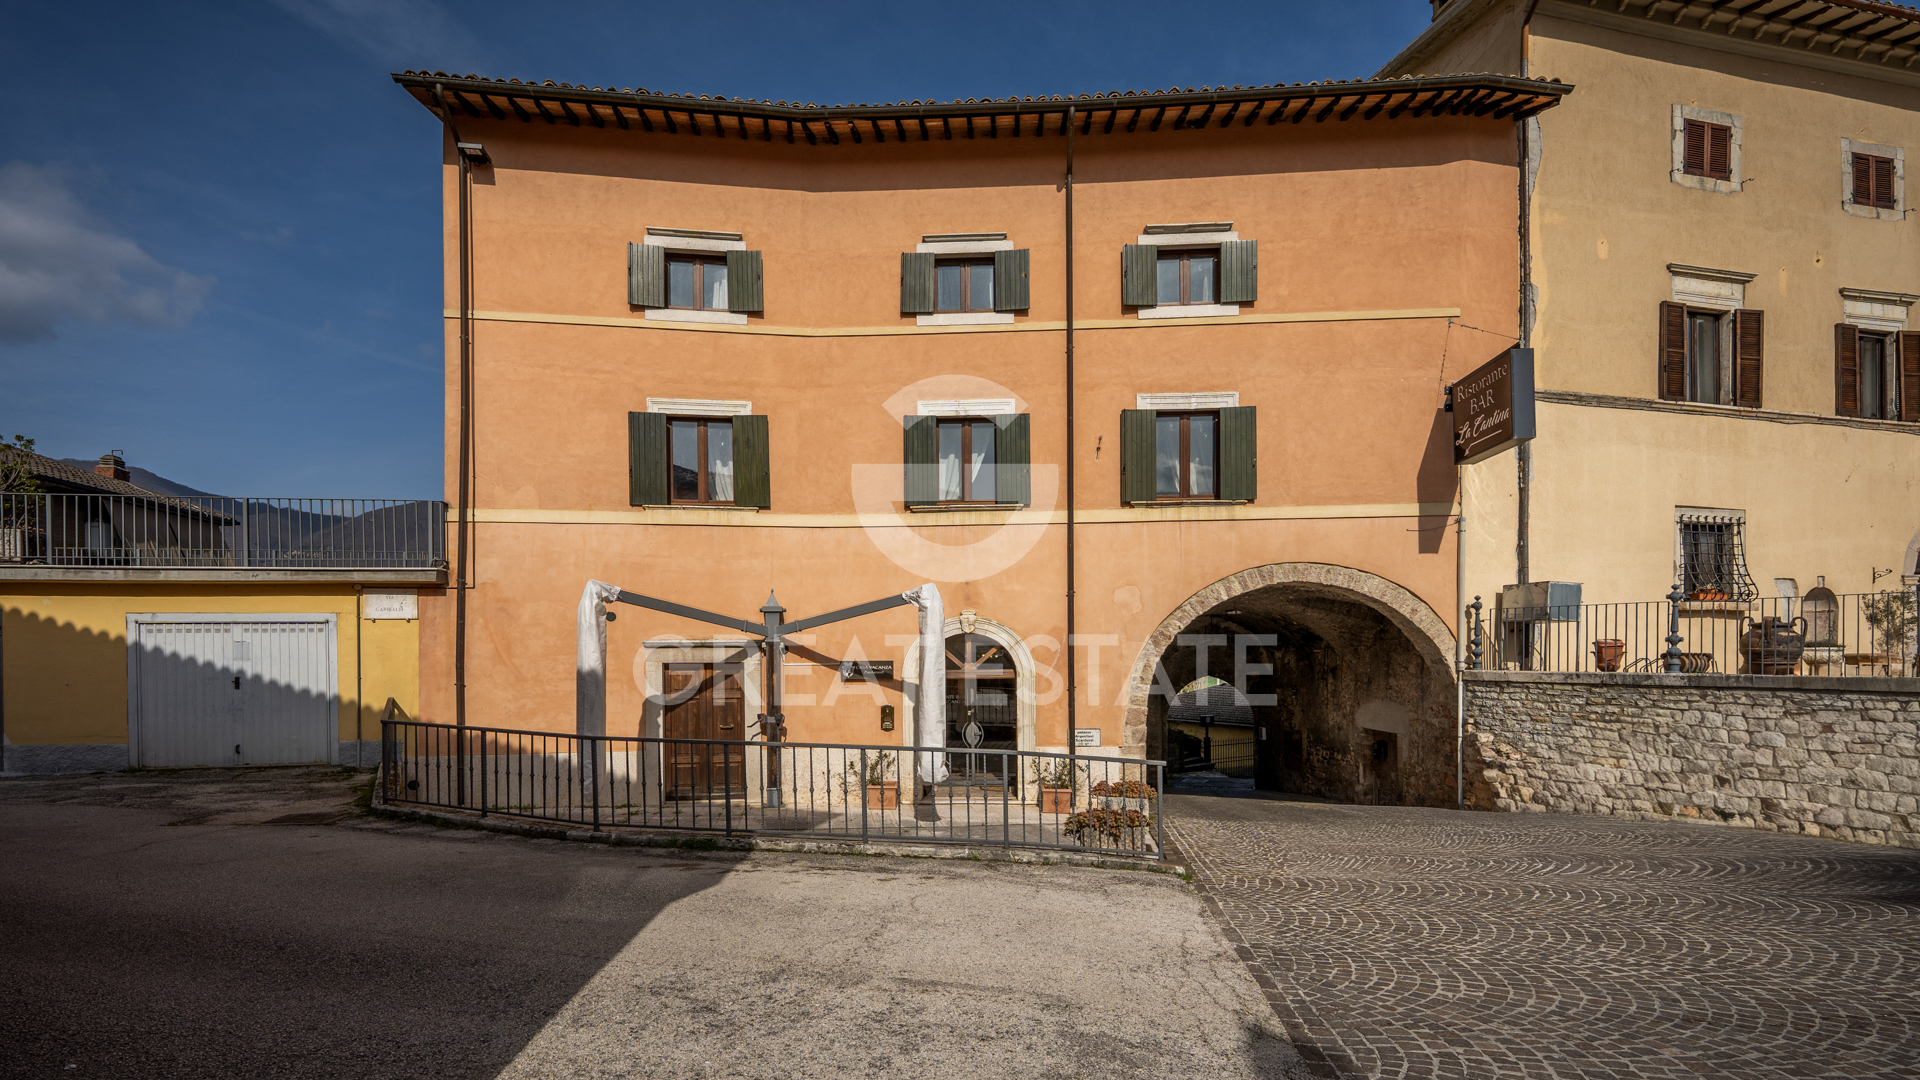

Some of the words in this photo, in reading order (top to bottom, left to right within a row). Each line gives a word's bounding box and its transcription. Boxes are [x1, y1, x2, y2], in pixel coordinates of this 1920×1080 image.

[1457, 364, 1508, 403] Ristorante
[1470, 389, 1495, 415] BAR
[1455, 421, 1471, 446] La
[1473, 407, 1510, 437] Cantina
